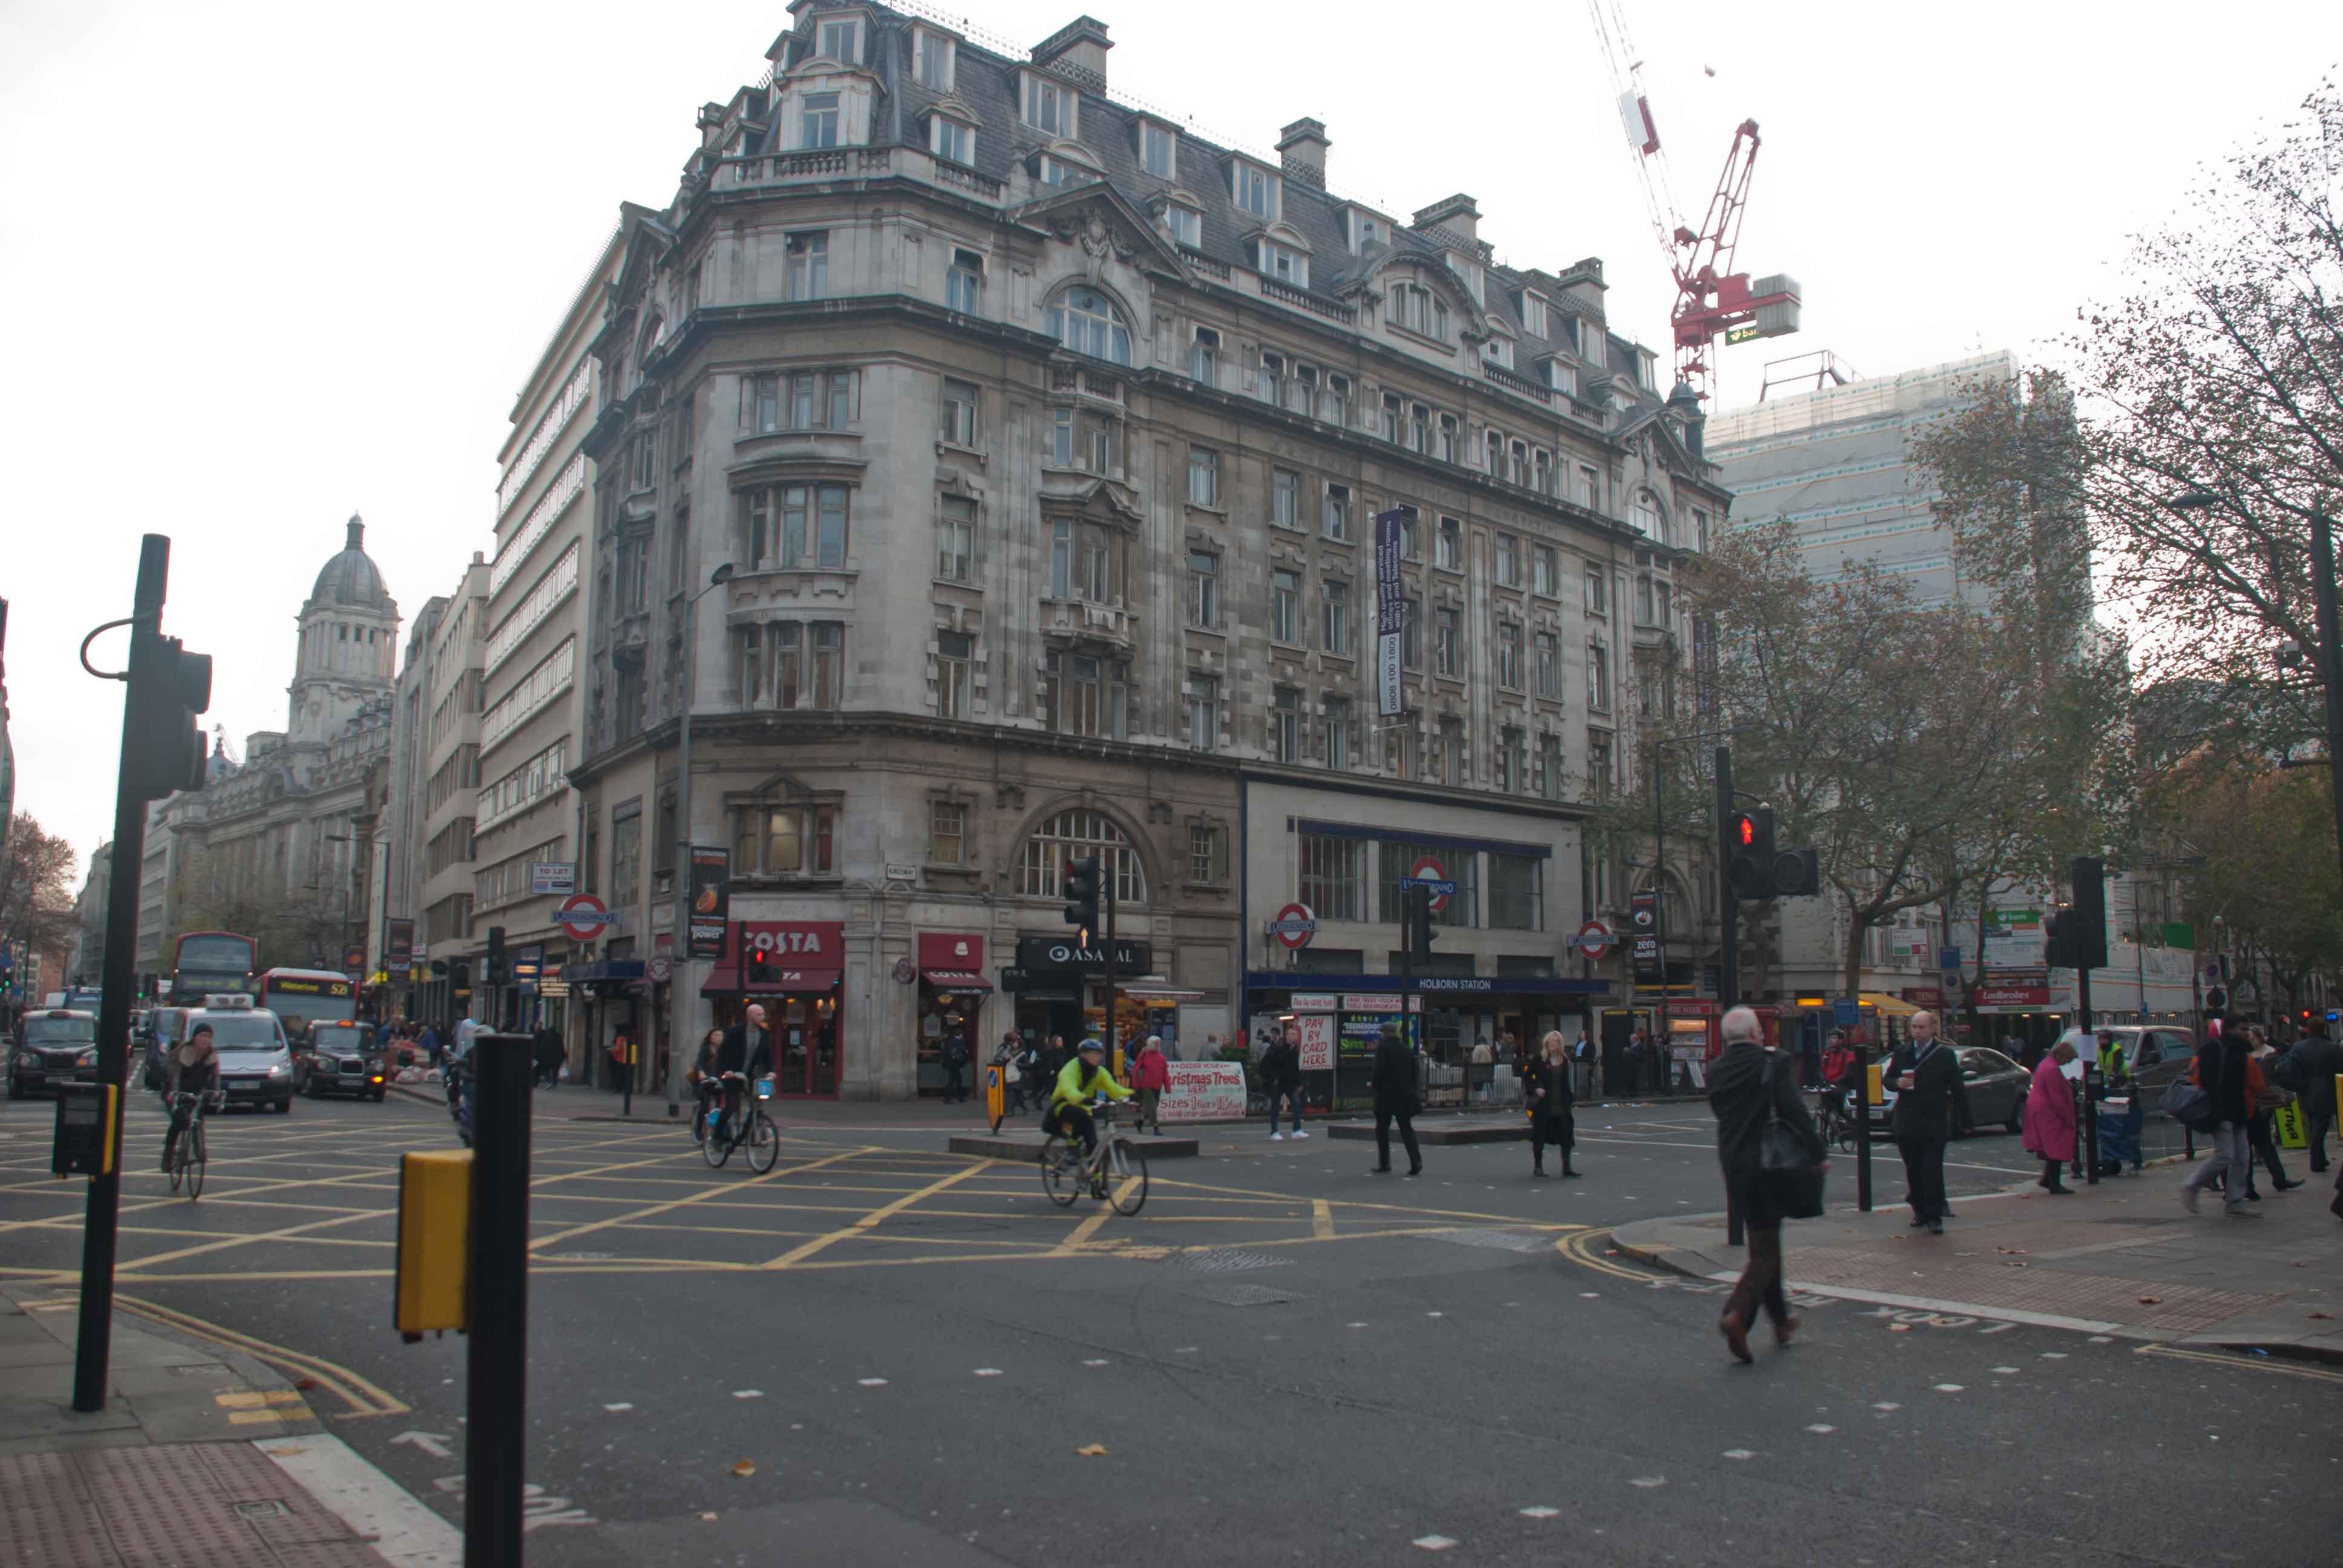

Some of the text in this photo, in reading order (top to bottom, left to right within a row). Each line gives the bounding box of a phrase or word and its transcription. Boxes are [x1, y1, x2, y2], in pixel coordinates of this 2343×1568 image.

[1743, 328, 1760, 338] ba
[1403, 879, 1453, 893] UROUND
[1636, 941, 1656, 949] zero
[1071, 948, 1133, 963] ASAAL
[329, 984, 349, 996] 521
[1420, 979, 1490, 990] HOLBORN STATION
[1982, 991, 2029, 999] Ladbrokes
[1305, 1018, 1323, 1029] PAY
[1308, 1030, 1320, 1041] BY
[1303, 1042, 1327, 1054] CARD
[1302, 1054, 1327, 1065] HERE
[1168, 1071, 1240, 1085] ristmas Trees
